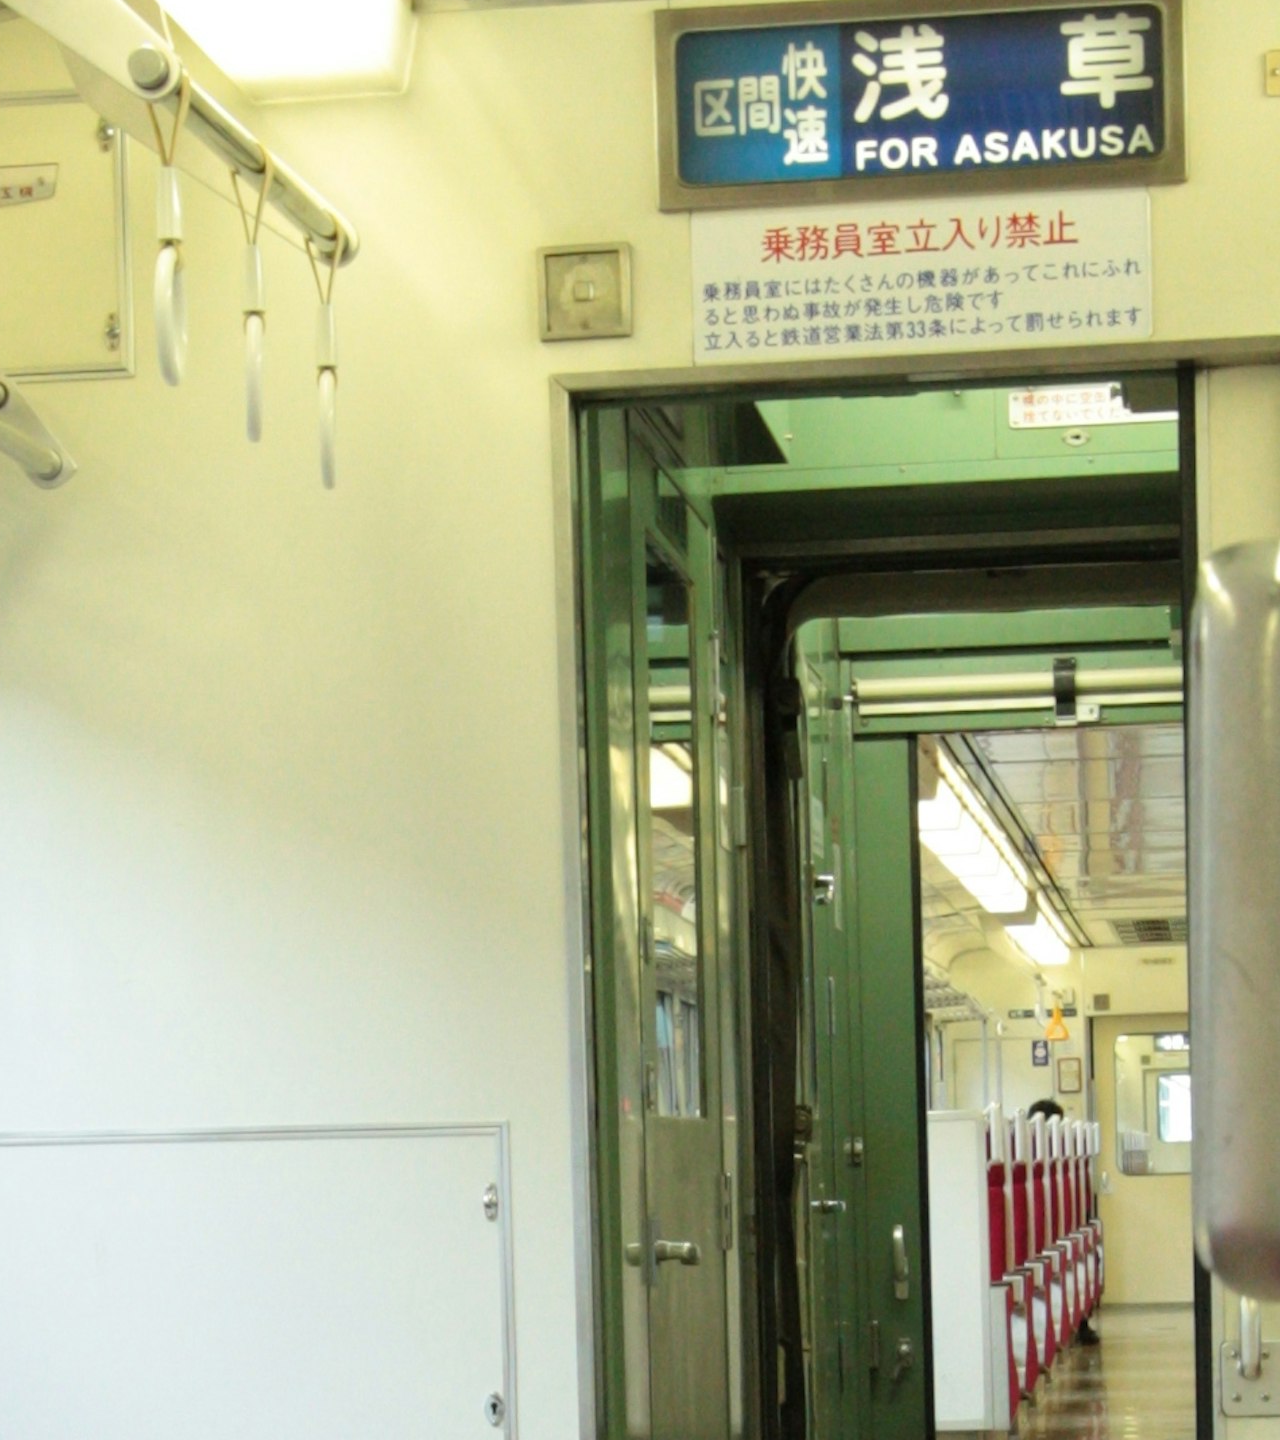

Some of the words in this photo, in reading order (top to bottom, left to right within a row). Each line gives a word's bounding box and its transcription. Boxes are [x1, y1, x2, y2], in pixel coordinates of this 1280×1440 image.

[852, 13, 1155, 123] 浅草
[693, 74, 781, 137] 区間
[782, 41, 829, 166] 快速
[855, 136, 938, 171] FOR
[954, 123, 1155, 165] ASAKUSA
[761, 210, 1079, 264] 乗務員室立入り禁止
[702, 257, 1142, 303] 乗務員室にはたくさんの機器があってこれにふれ
[703, 305, 1144, 351] 立入ると鉄道営業法第33条によって罰せられます
[704, 289, 1005, 328] ると思わぬ事故が発生し危険です
